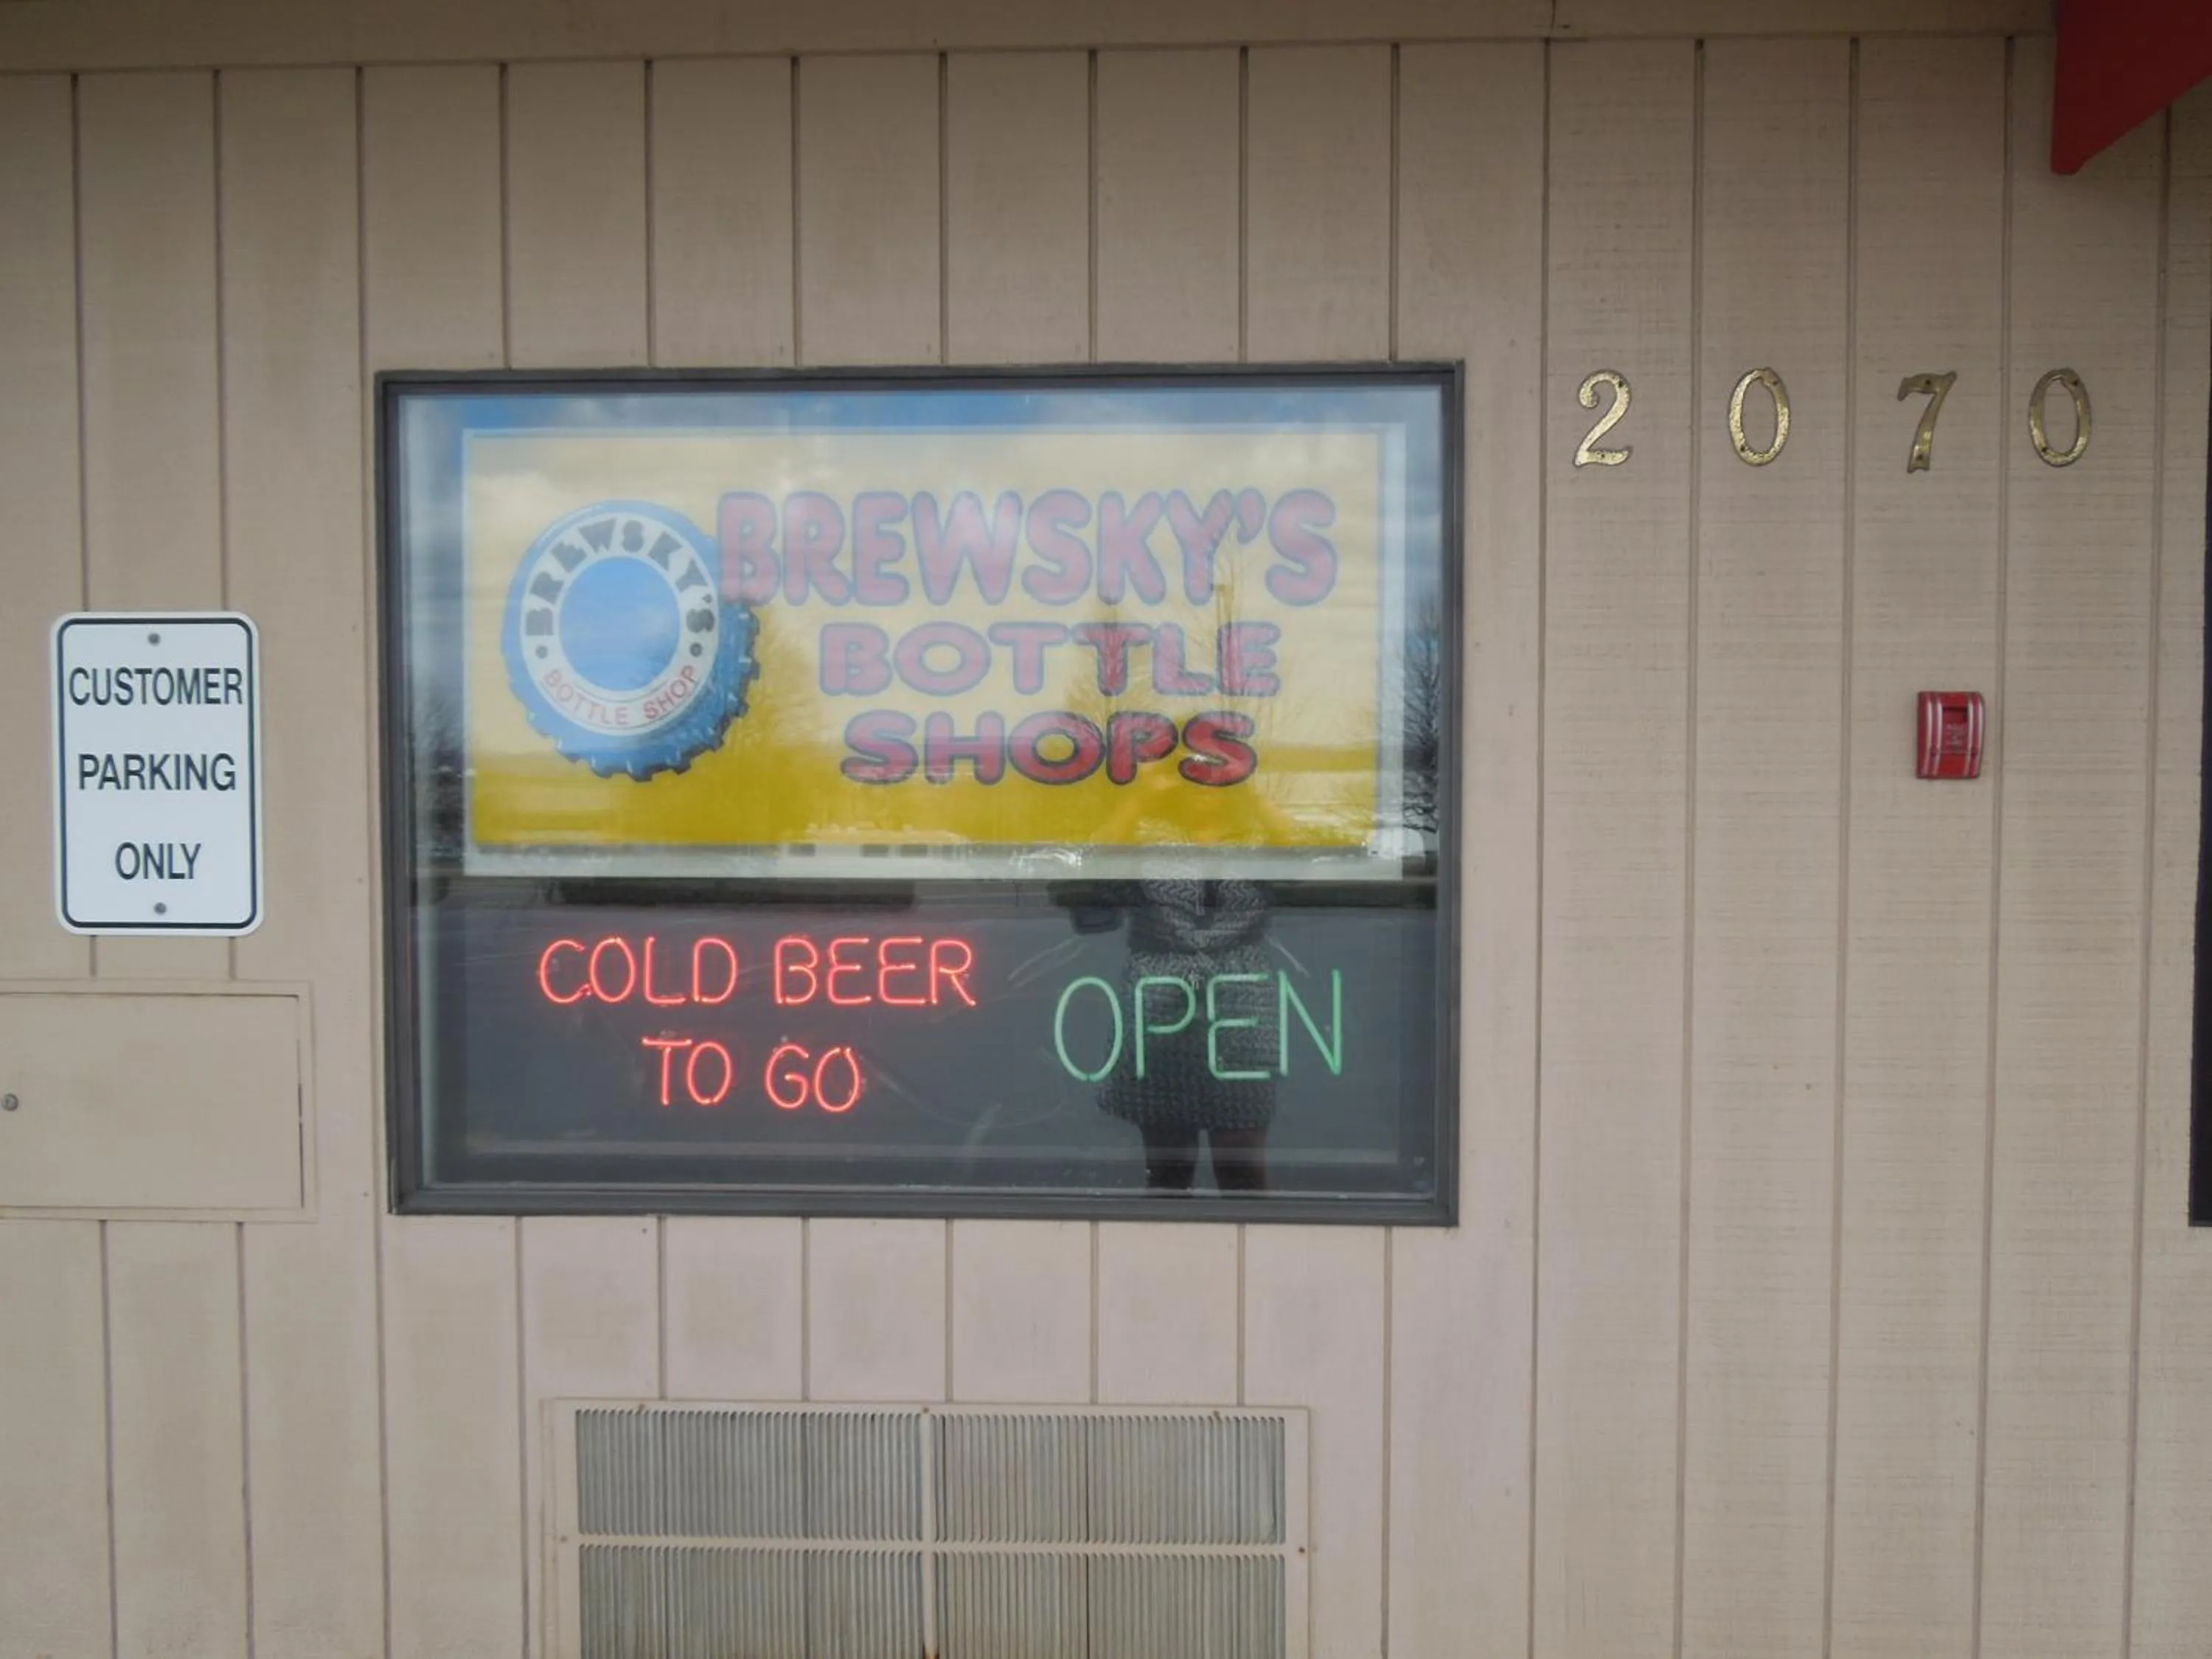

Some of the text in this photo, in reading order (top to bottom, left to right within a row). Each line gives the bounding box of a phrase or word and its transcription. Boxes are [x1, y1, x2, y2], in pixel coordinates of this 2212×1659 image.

[715, 487, 1339, 608] BREWSKY'S
[69, 667, 243, 706] CUSTOMER
[542, 664, 696, 726] BOTTLE SHOP
[818, 620, 1282, 697] BOTTLE
[77, 753, 236, 791] PARKING
[839, 709, 1257, 787] SHOPS
[114, 841, 201, 880] ONLY
[539, 935, 978, 1007] COLD BEER
[1053, 968, 1343, 1082] OPEN
[640, 1036, 862, 1113] TO GO
